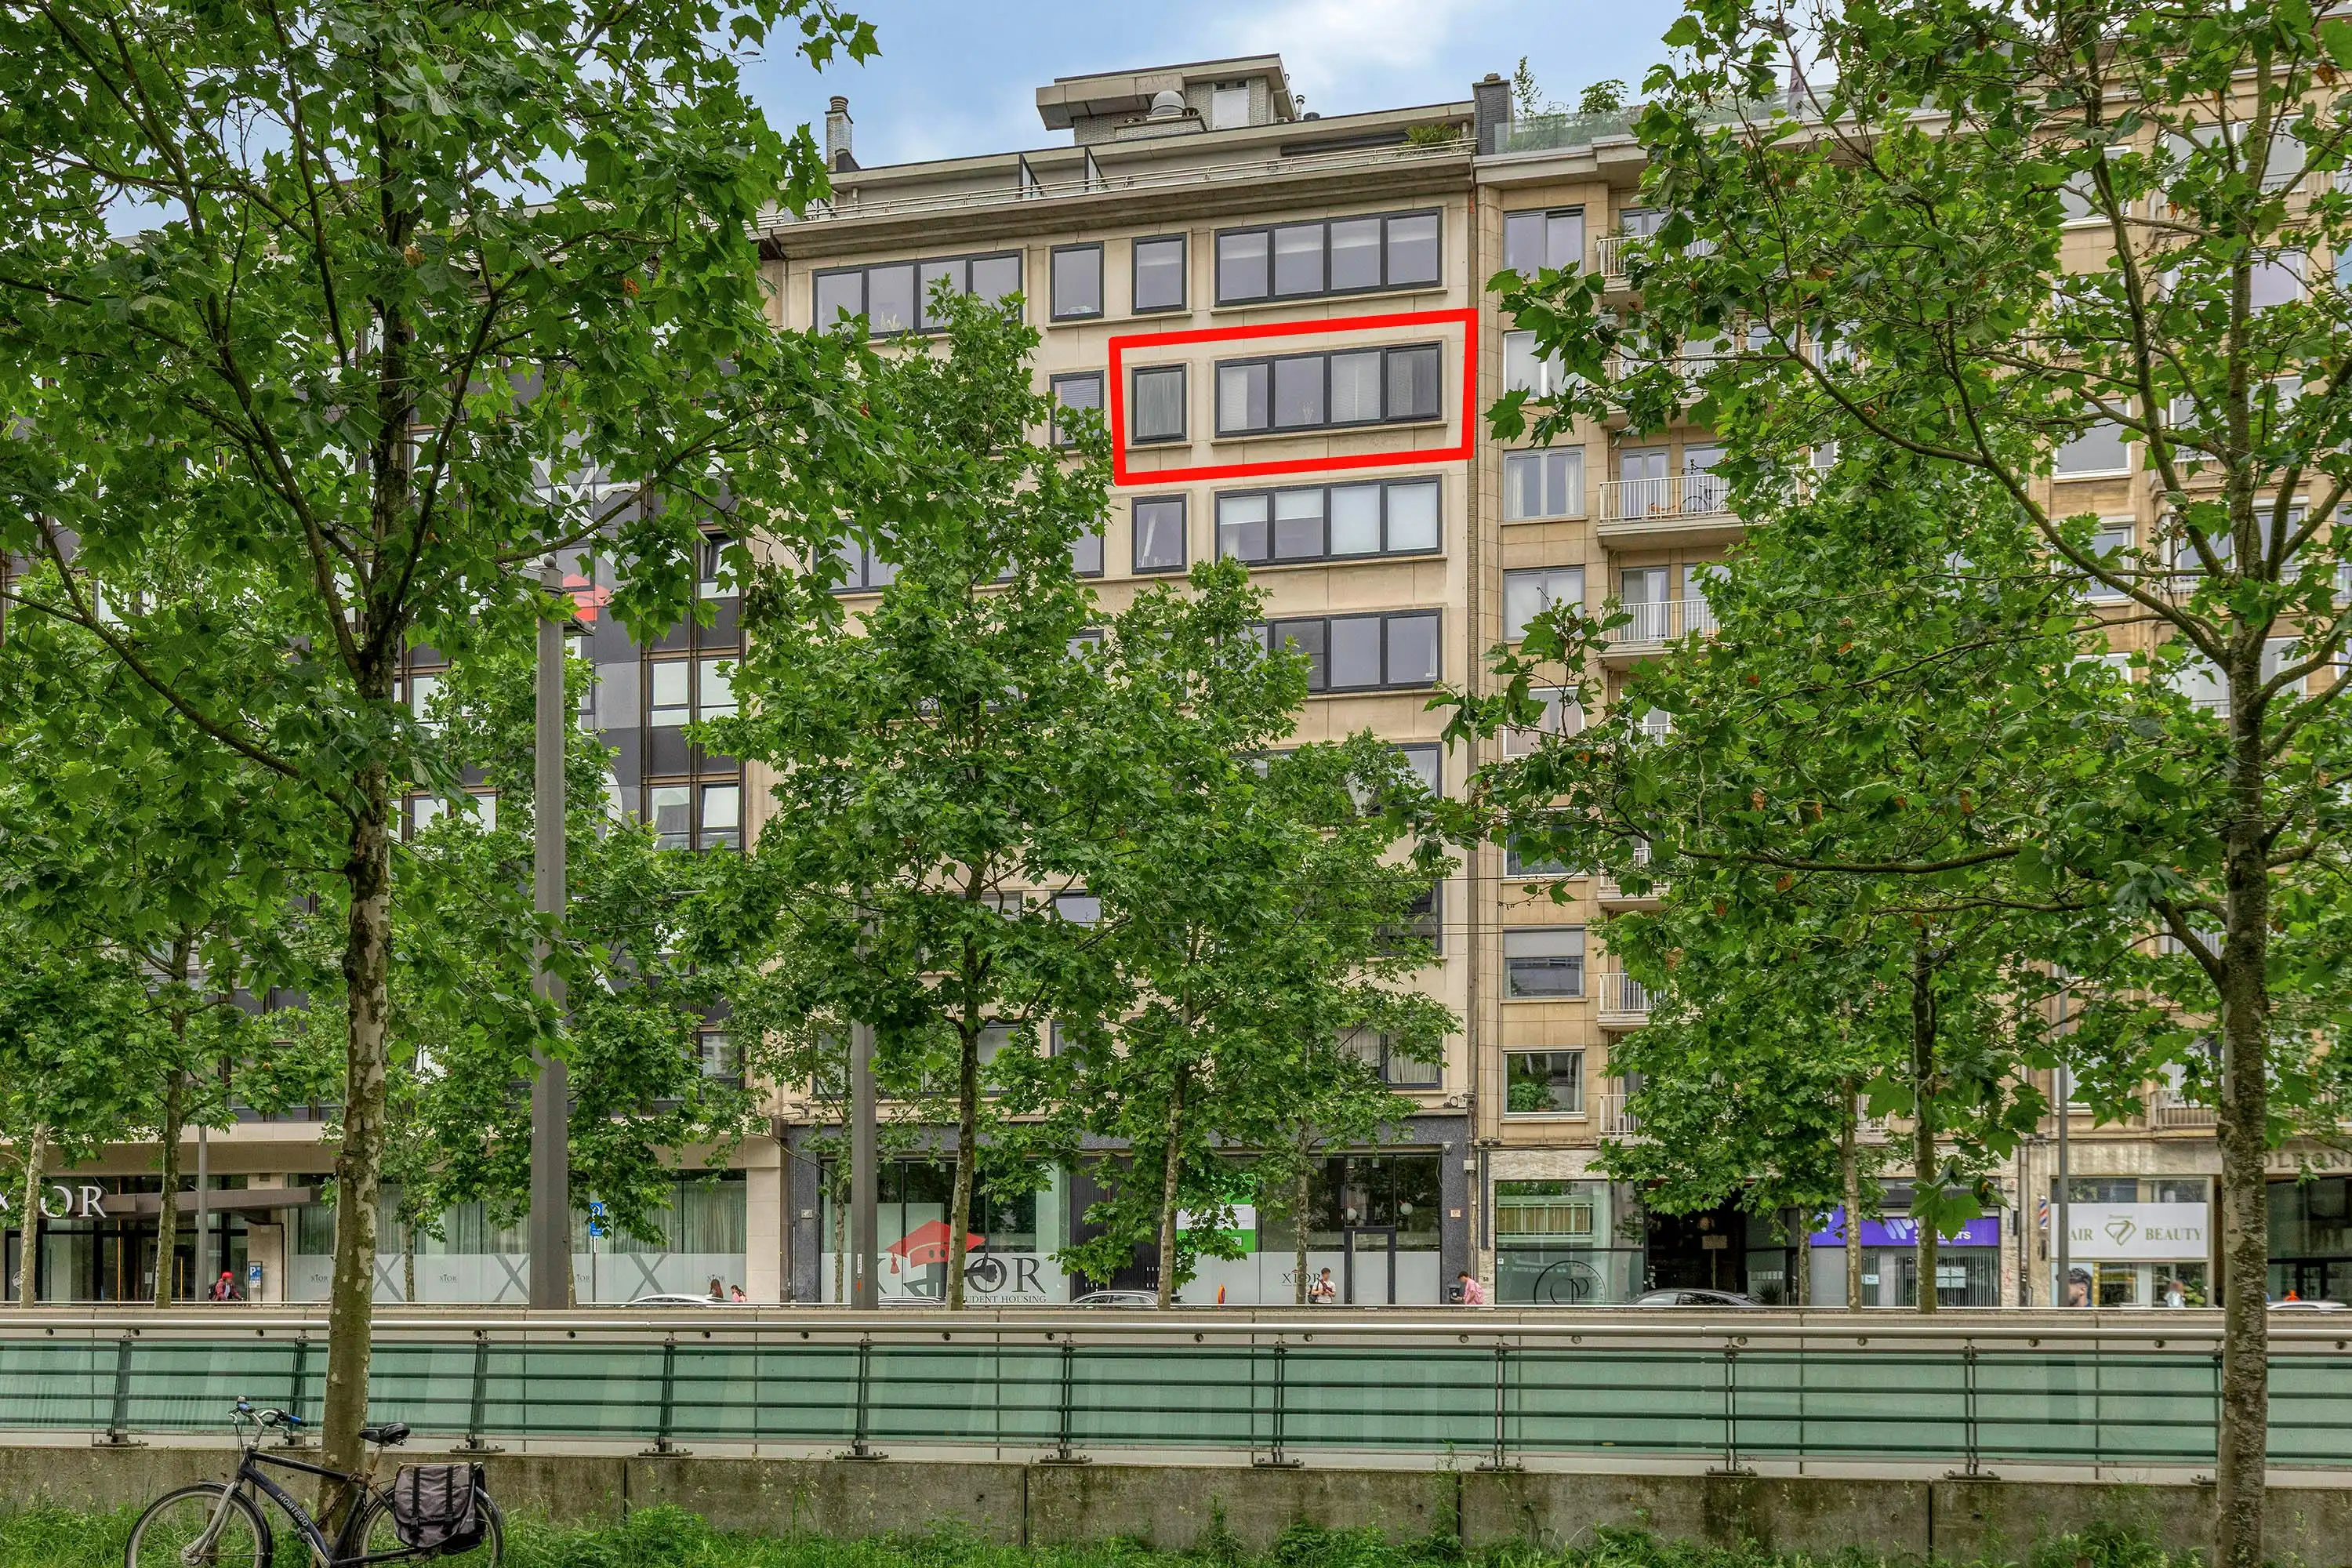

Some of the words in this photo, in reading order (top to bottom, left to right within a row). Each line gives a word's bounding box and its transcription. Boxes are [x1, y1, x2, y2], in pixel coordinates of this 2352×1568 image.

[2068, 1228, 2094, 1240] AIR
[2145, 1228, 2203, 1240] BEAUTY
[965, 1295, 998, 1304] UDENT
[1001, 1295, 1047, 1304] HOUSING
[276, 1492, 310, 1526] MONTEGO
